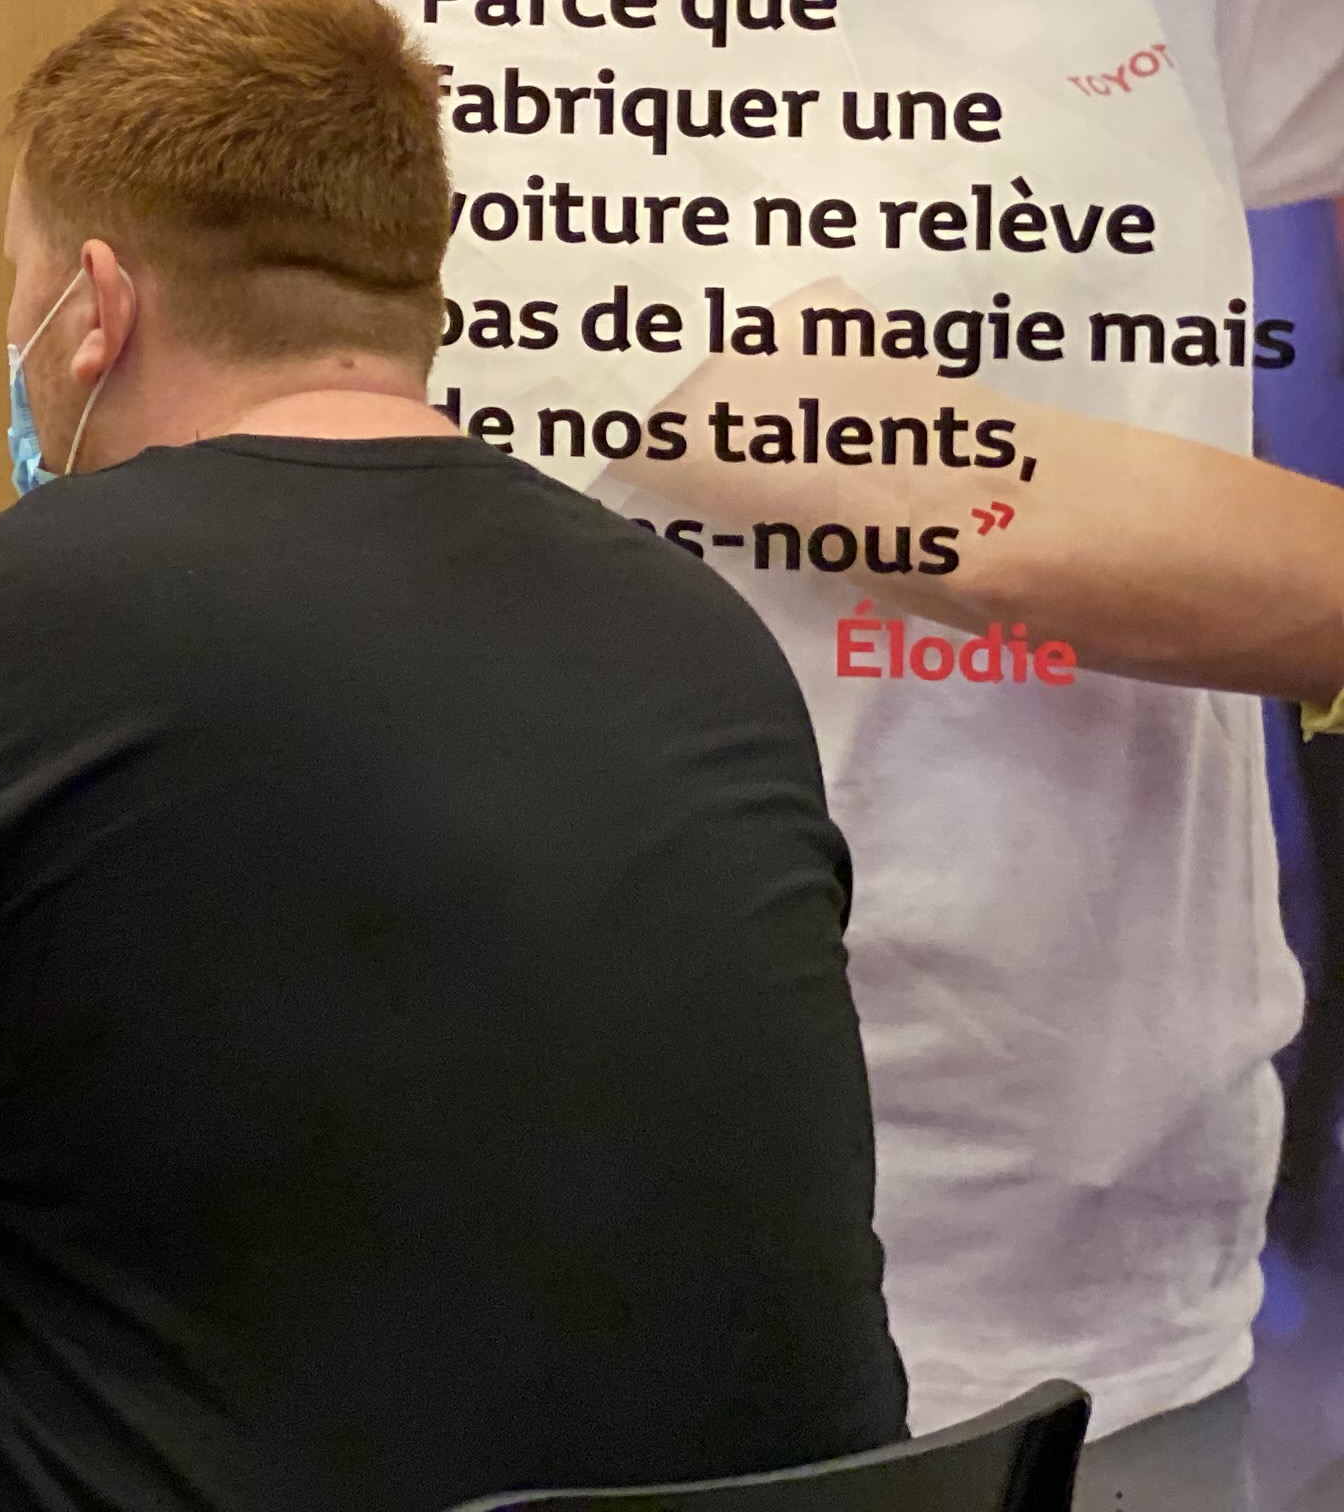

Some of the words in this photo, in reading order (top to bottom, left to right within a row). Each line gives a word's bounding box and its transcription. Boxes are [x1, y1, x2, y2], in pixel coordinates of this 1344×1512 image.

[841, 89, 1003, 143] une
[754, 197, 858, 250] ne
[879, 178, 1157, 254] relève
[580, 286, 683, 354] de
[707, 288, 780, 356] la
[800, 293, 1066, 378] magie
[1088, 298, 1297, 371] mais
[538, 404, 688, 460] nos
[710, 398, 1039, 482] talents,
[834, 599, 1078, 685] Élodie
